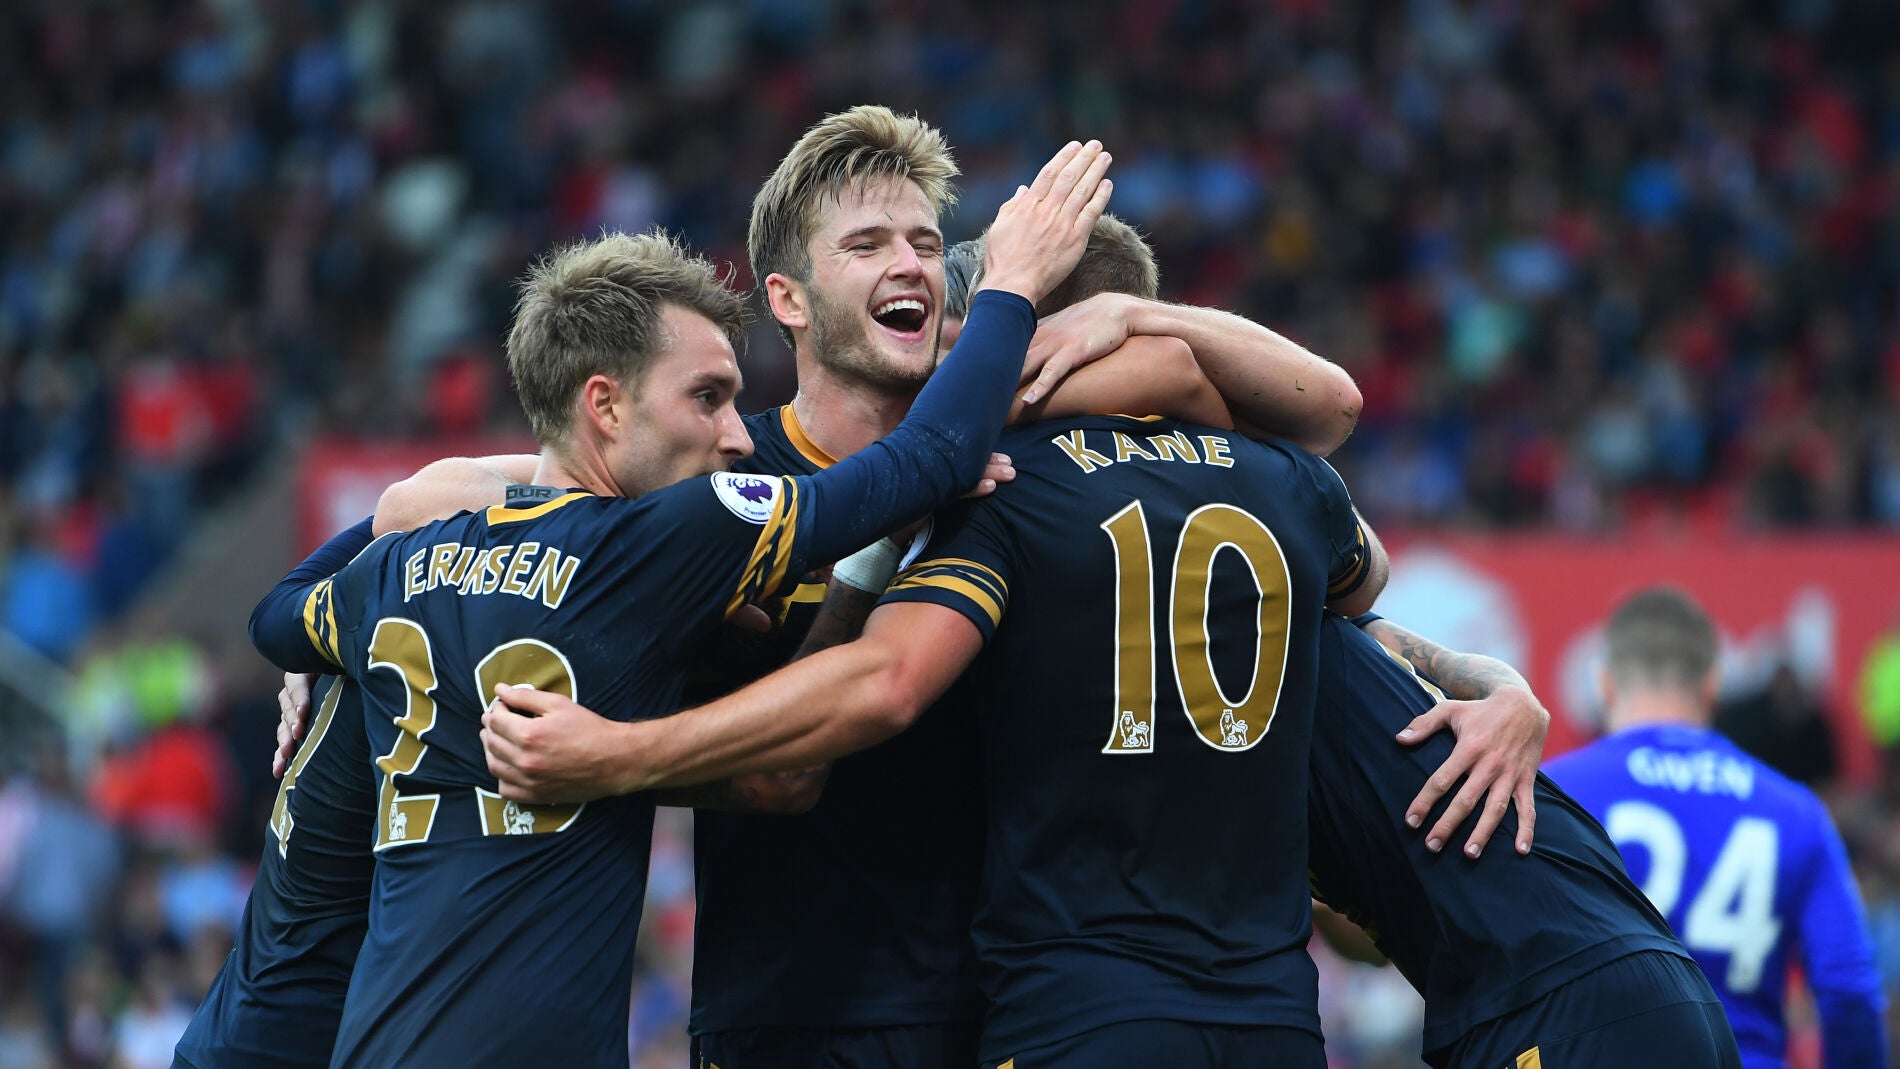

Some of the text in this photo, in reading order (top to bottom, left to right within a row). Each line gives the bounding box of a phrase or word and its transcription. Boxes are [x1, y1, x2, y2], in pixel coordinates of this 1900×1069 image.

[1051, 429, 1235, 474] KANE
[403, 541, 582, 610] ERIKSEN
[1100, 499, 1292, 753] 10
[1626, 746, 1755, 800] GIVEN
